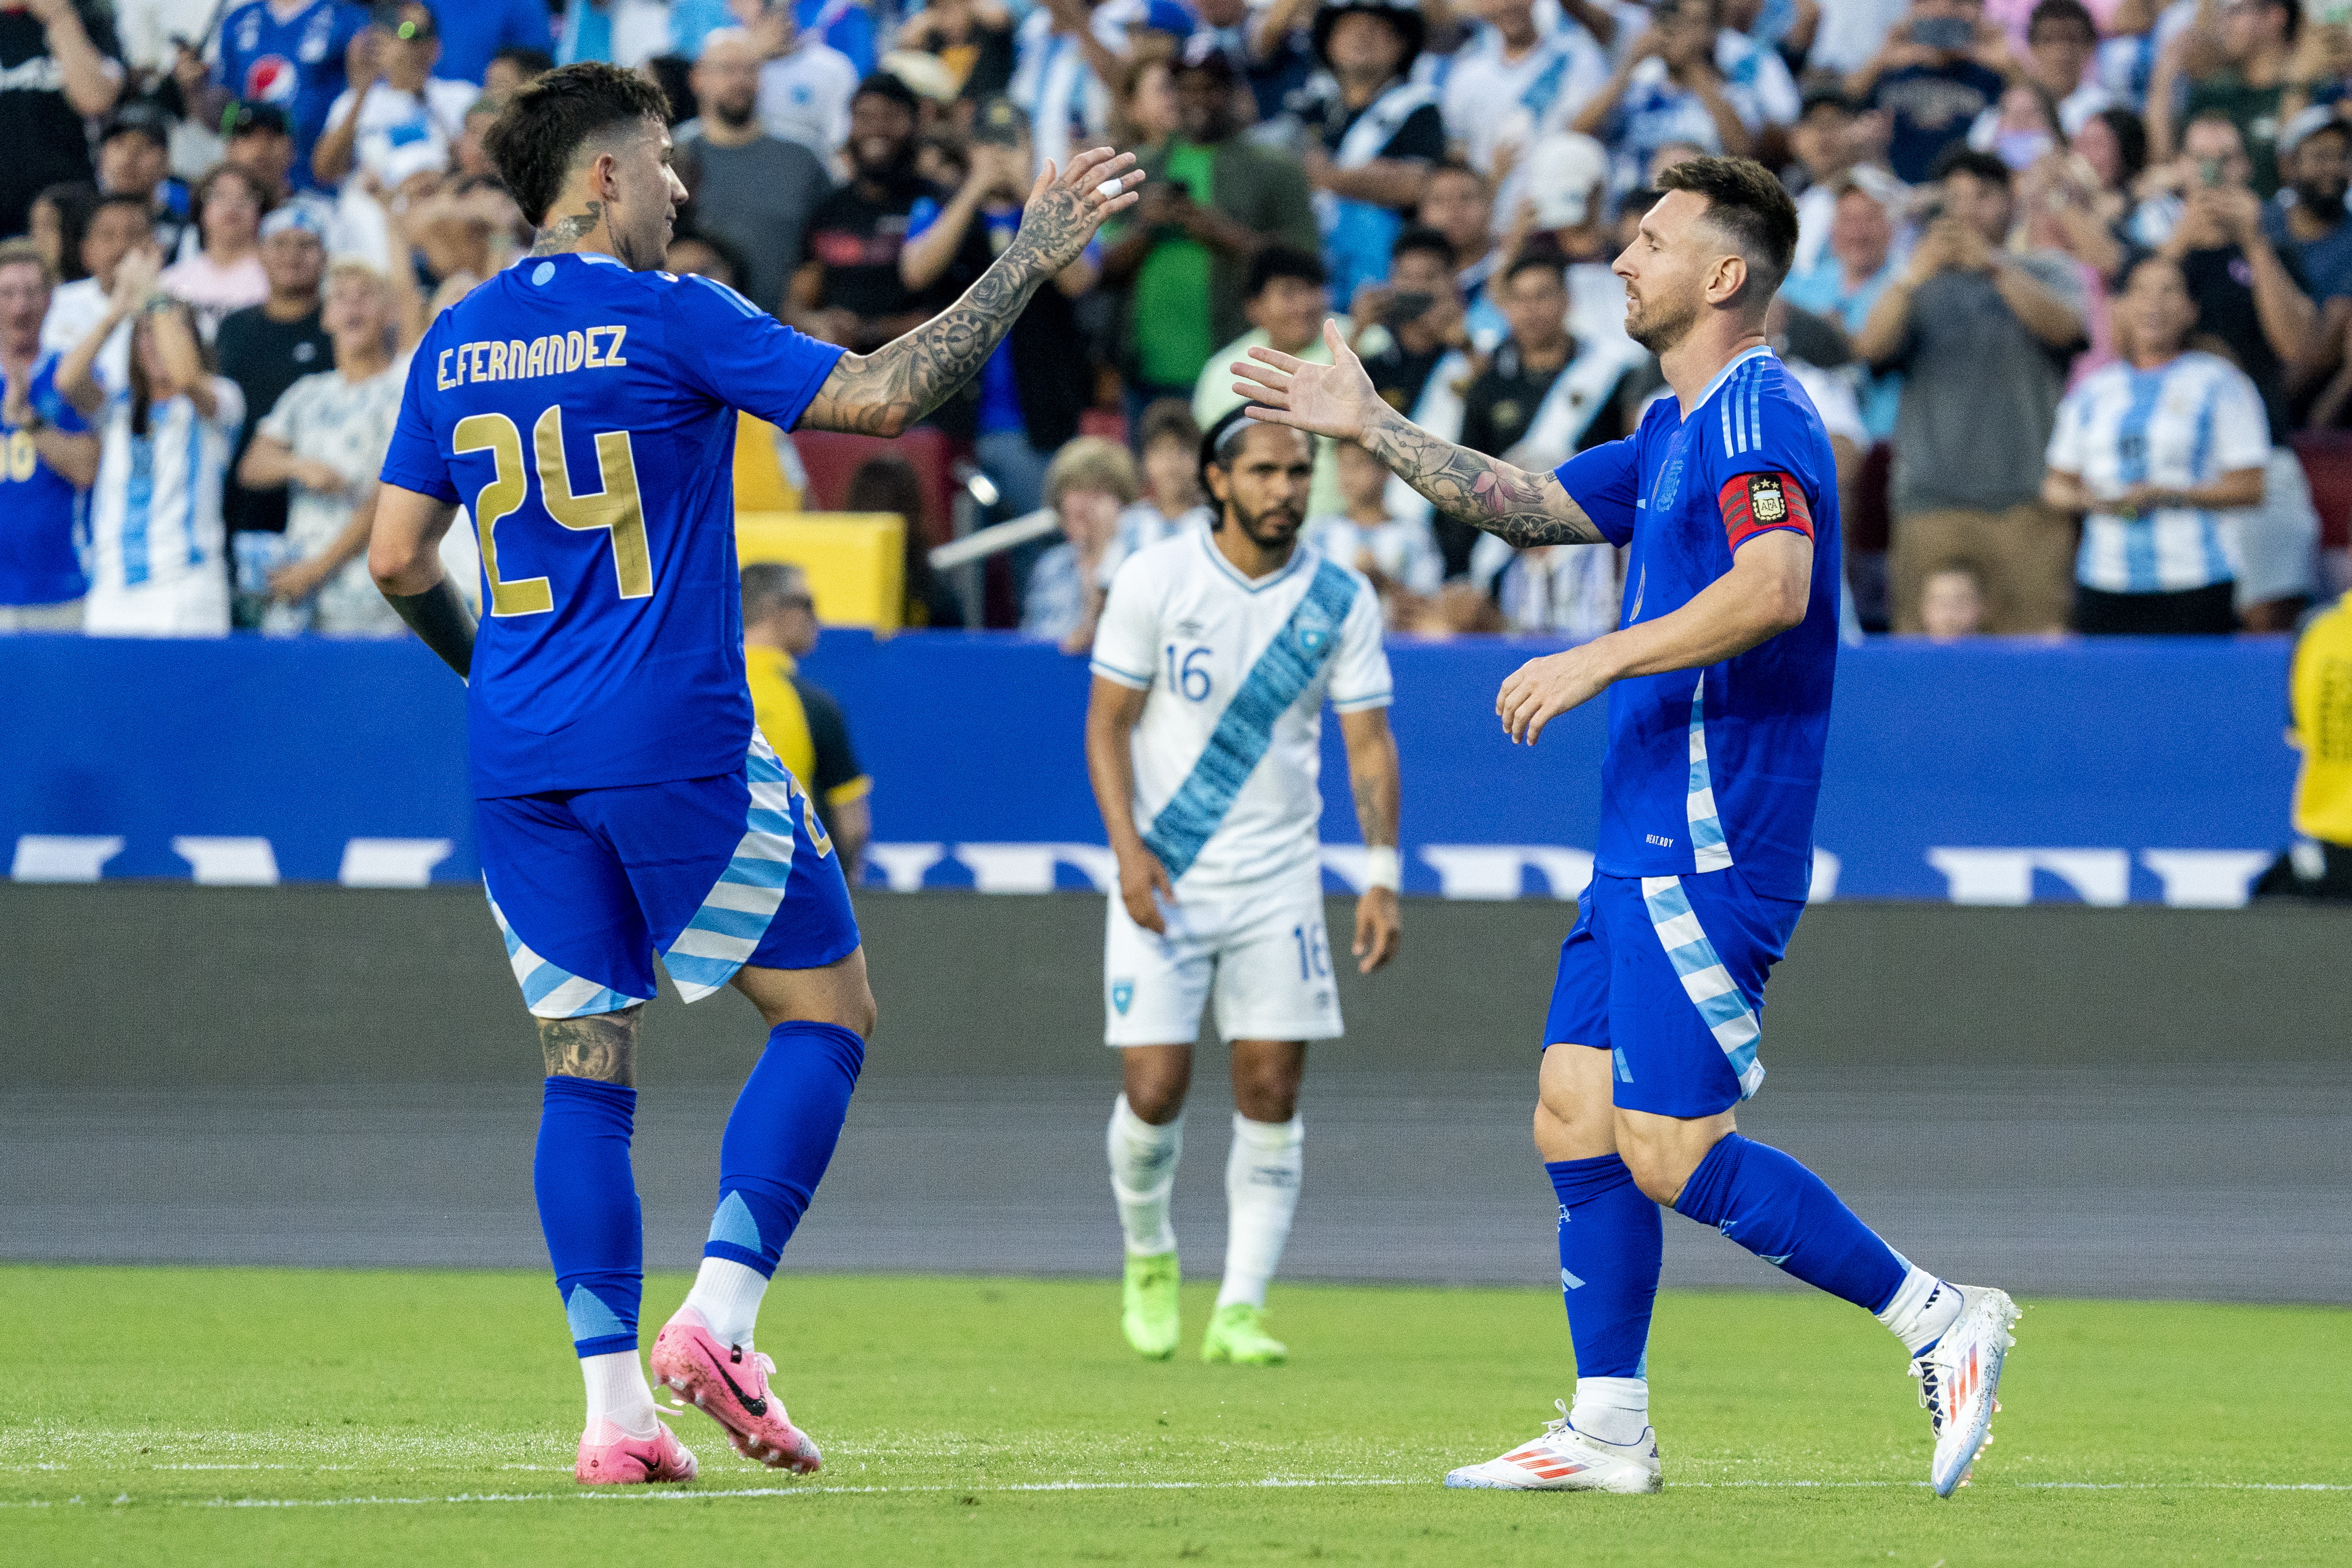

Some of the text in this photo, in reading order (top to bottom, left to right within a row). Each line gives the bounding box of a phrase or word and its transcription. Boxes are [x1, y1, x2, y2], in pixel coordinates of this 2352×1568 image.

[437, 325, 627, 391] E.FERNANDEZ
[452, 404, 654, 617] 24
[1761, 498, 1778, 511] AFA
[1166, 644, 1213, 703] 16
[1645, 833, 1674, 848] HEAT.RDY
